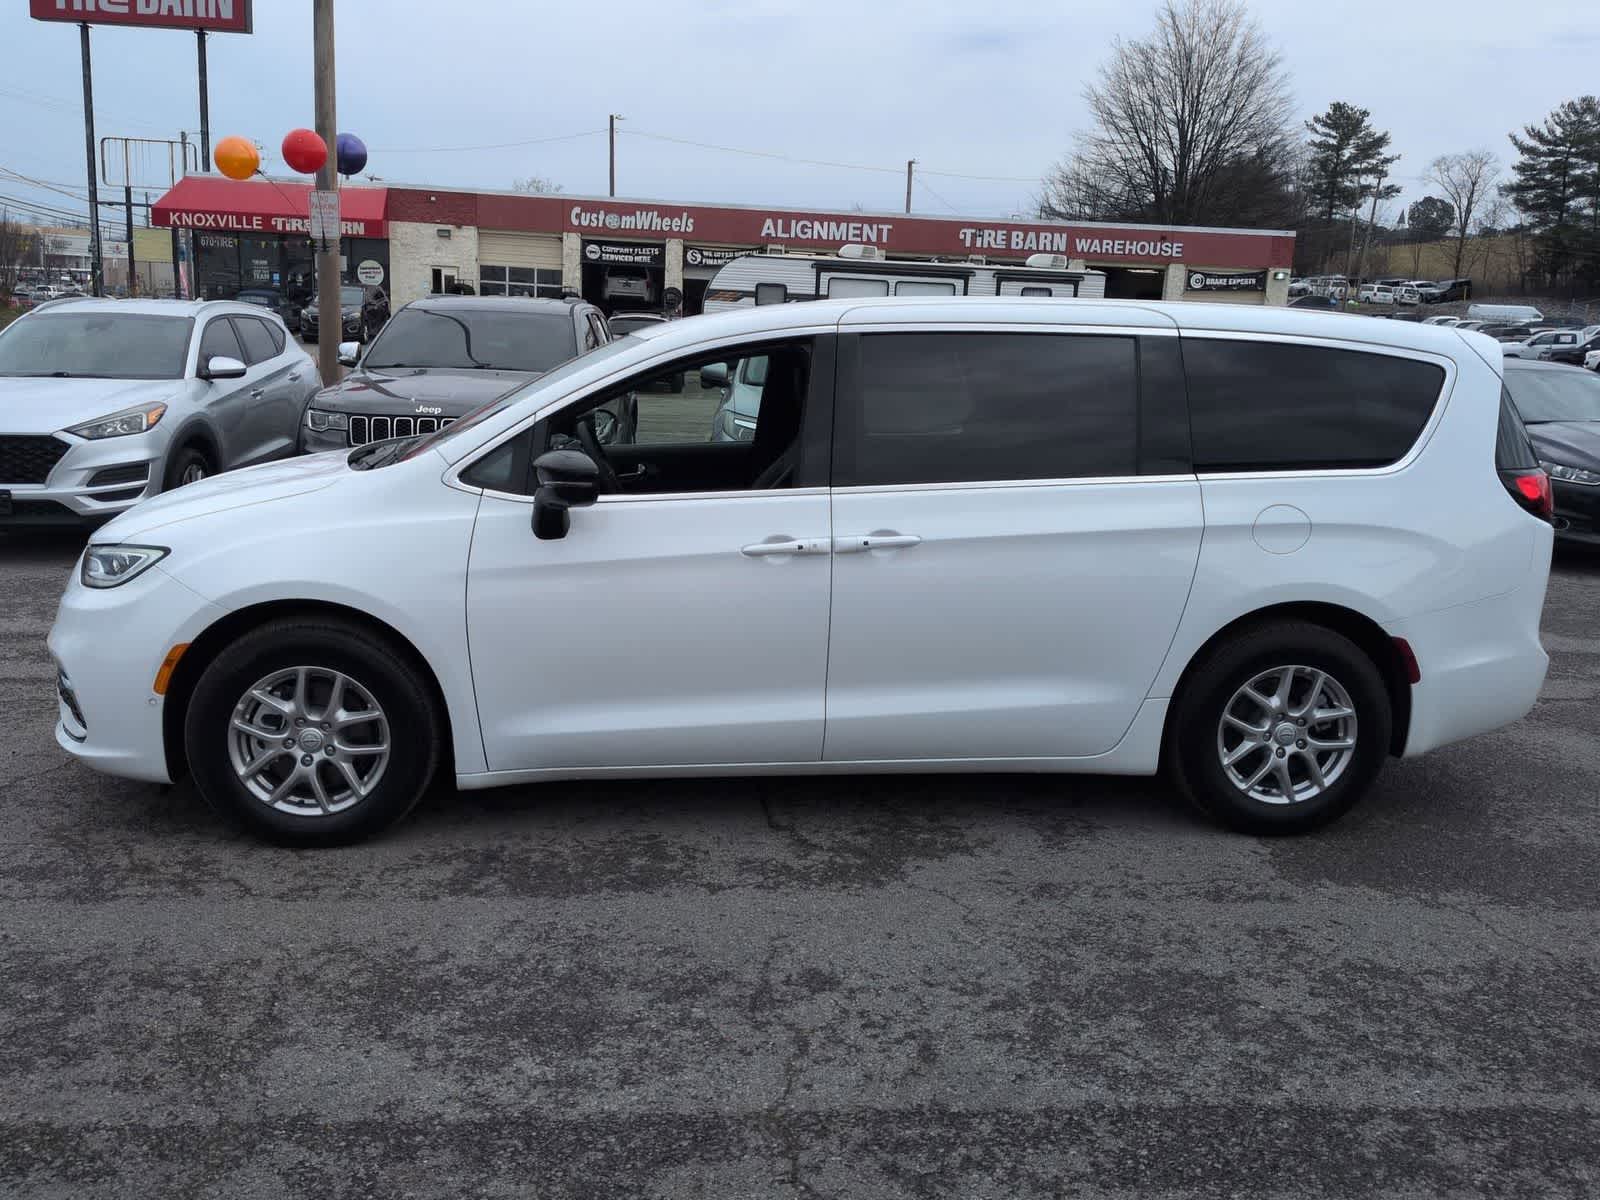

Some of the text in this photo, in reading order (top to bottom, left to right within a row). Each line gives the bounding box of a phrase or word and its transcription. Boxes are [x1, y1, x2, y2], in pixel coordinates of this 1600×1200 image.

[169, 212, 264, 230] KNOXVILLE
[760, 217, 893, 243] ALIGNMENT
[1010, 230, 1067, 252] BARN
[1075, 237, 1184, 257] WAREHOUSE
[601, 253, 652, 263] SERVICED HERE
[415, 404, 442, 415] Jeep
